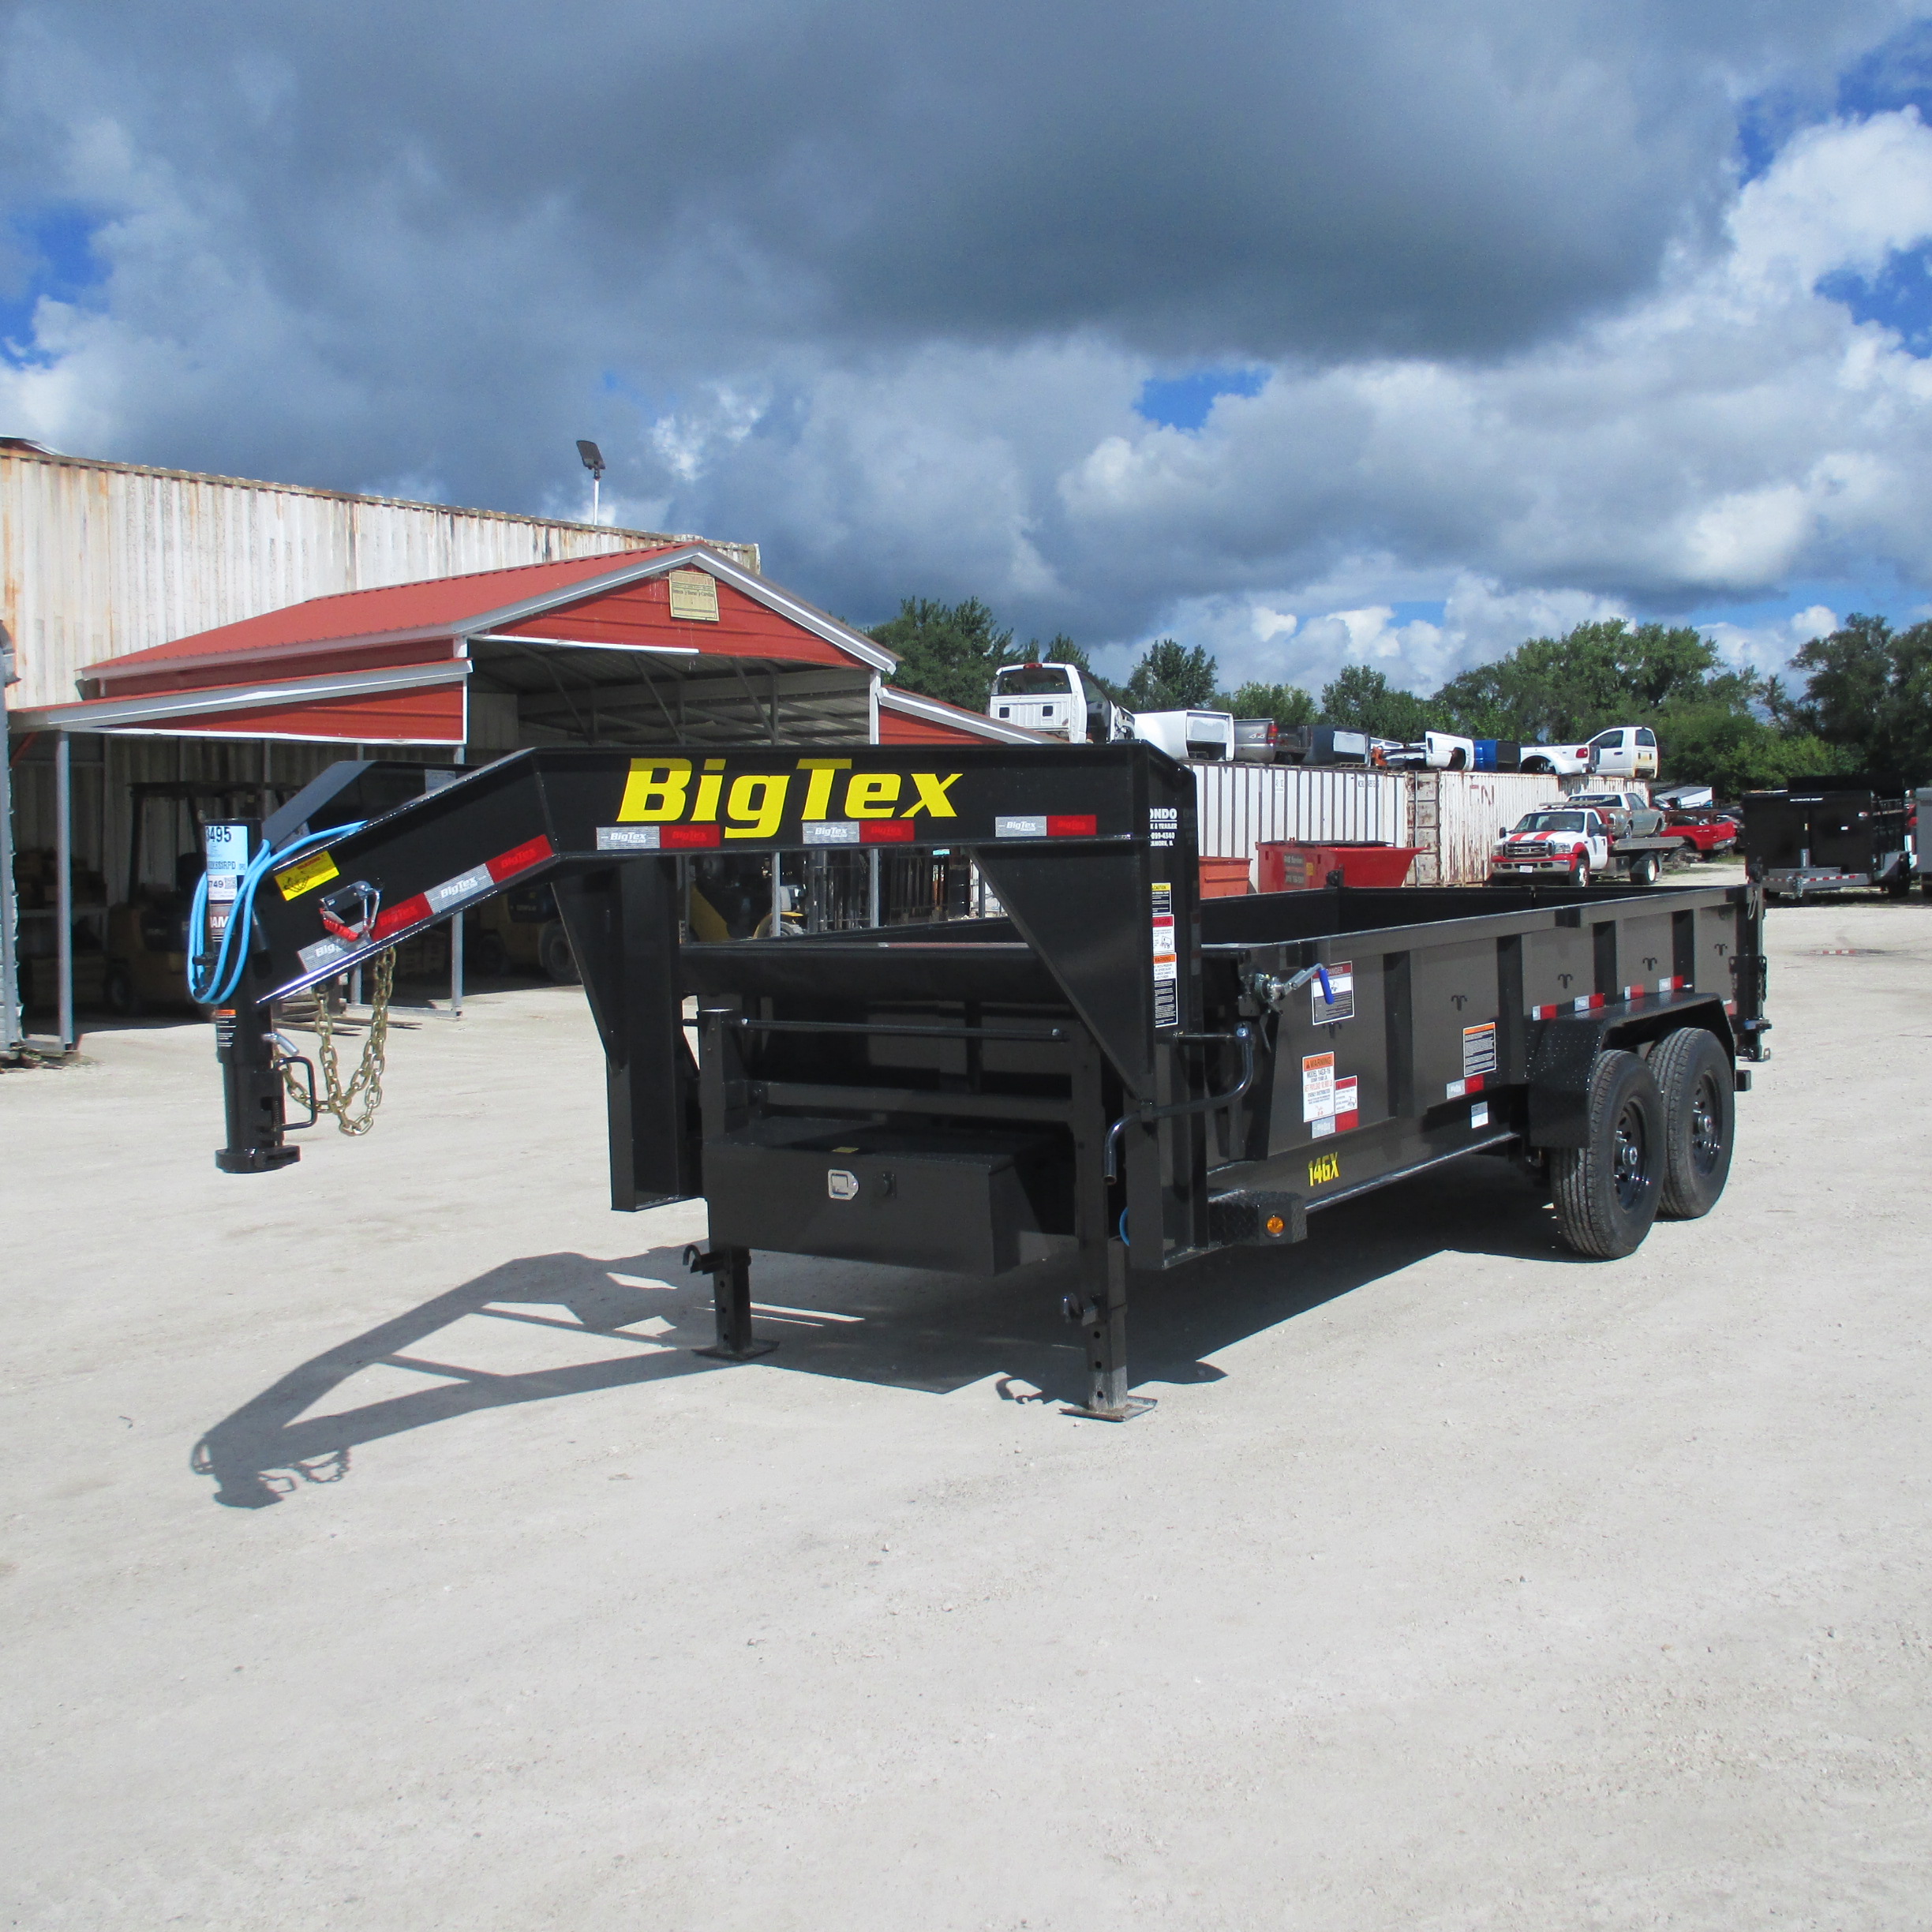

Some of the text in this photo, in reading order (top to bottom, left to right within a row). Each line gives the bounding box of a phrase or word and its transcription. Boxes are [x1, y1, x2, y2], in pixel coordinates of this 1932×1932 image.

[616, 758, 963, 839] BigTex
[611, 831, 646, 841] BigTex
[815, 827, 847, 837] BigTex
[440, 876, 477, 898] BigTex
[1310, 1057, 1331, 1068] WARNING
[1308, 1151, 1339, 1186] 14GX
